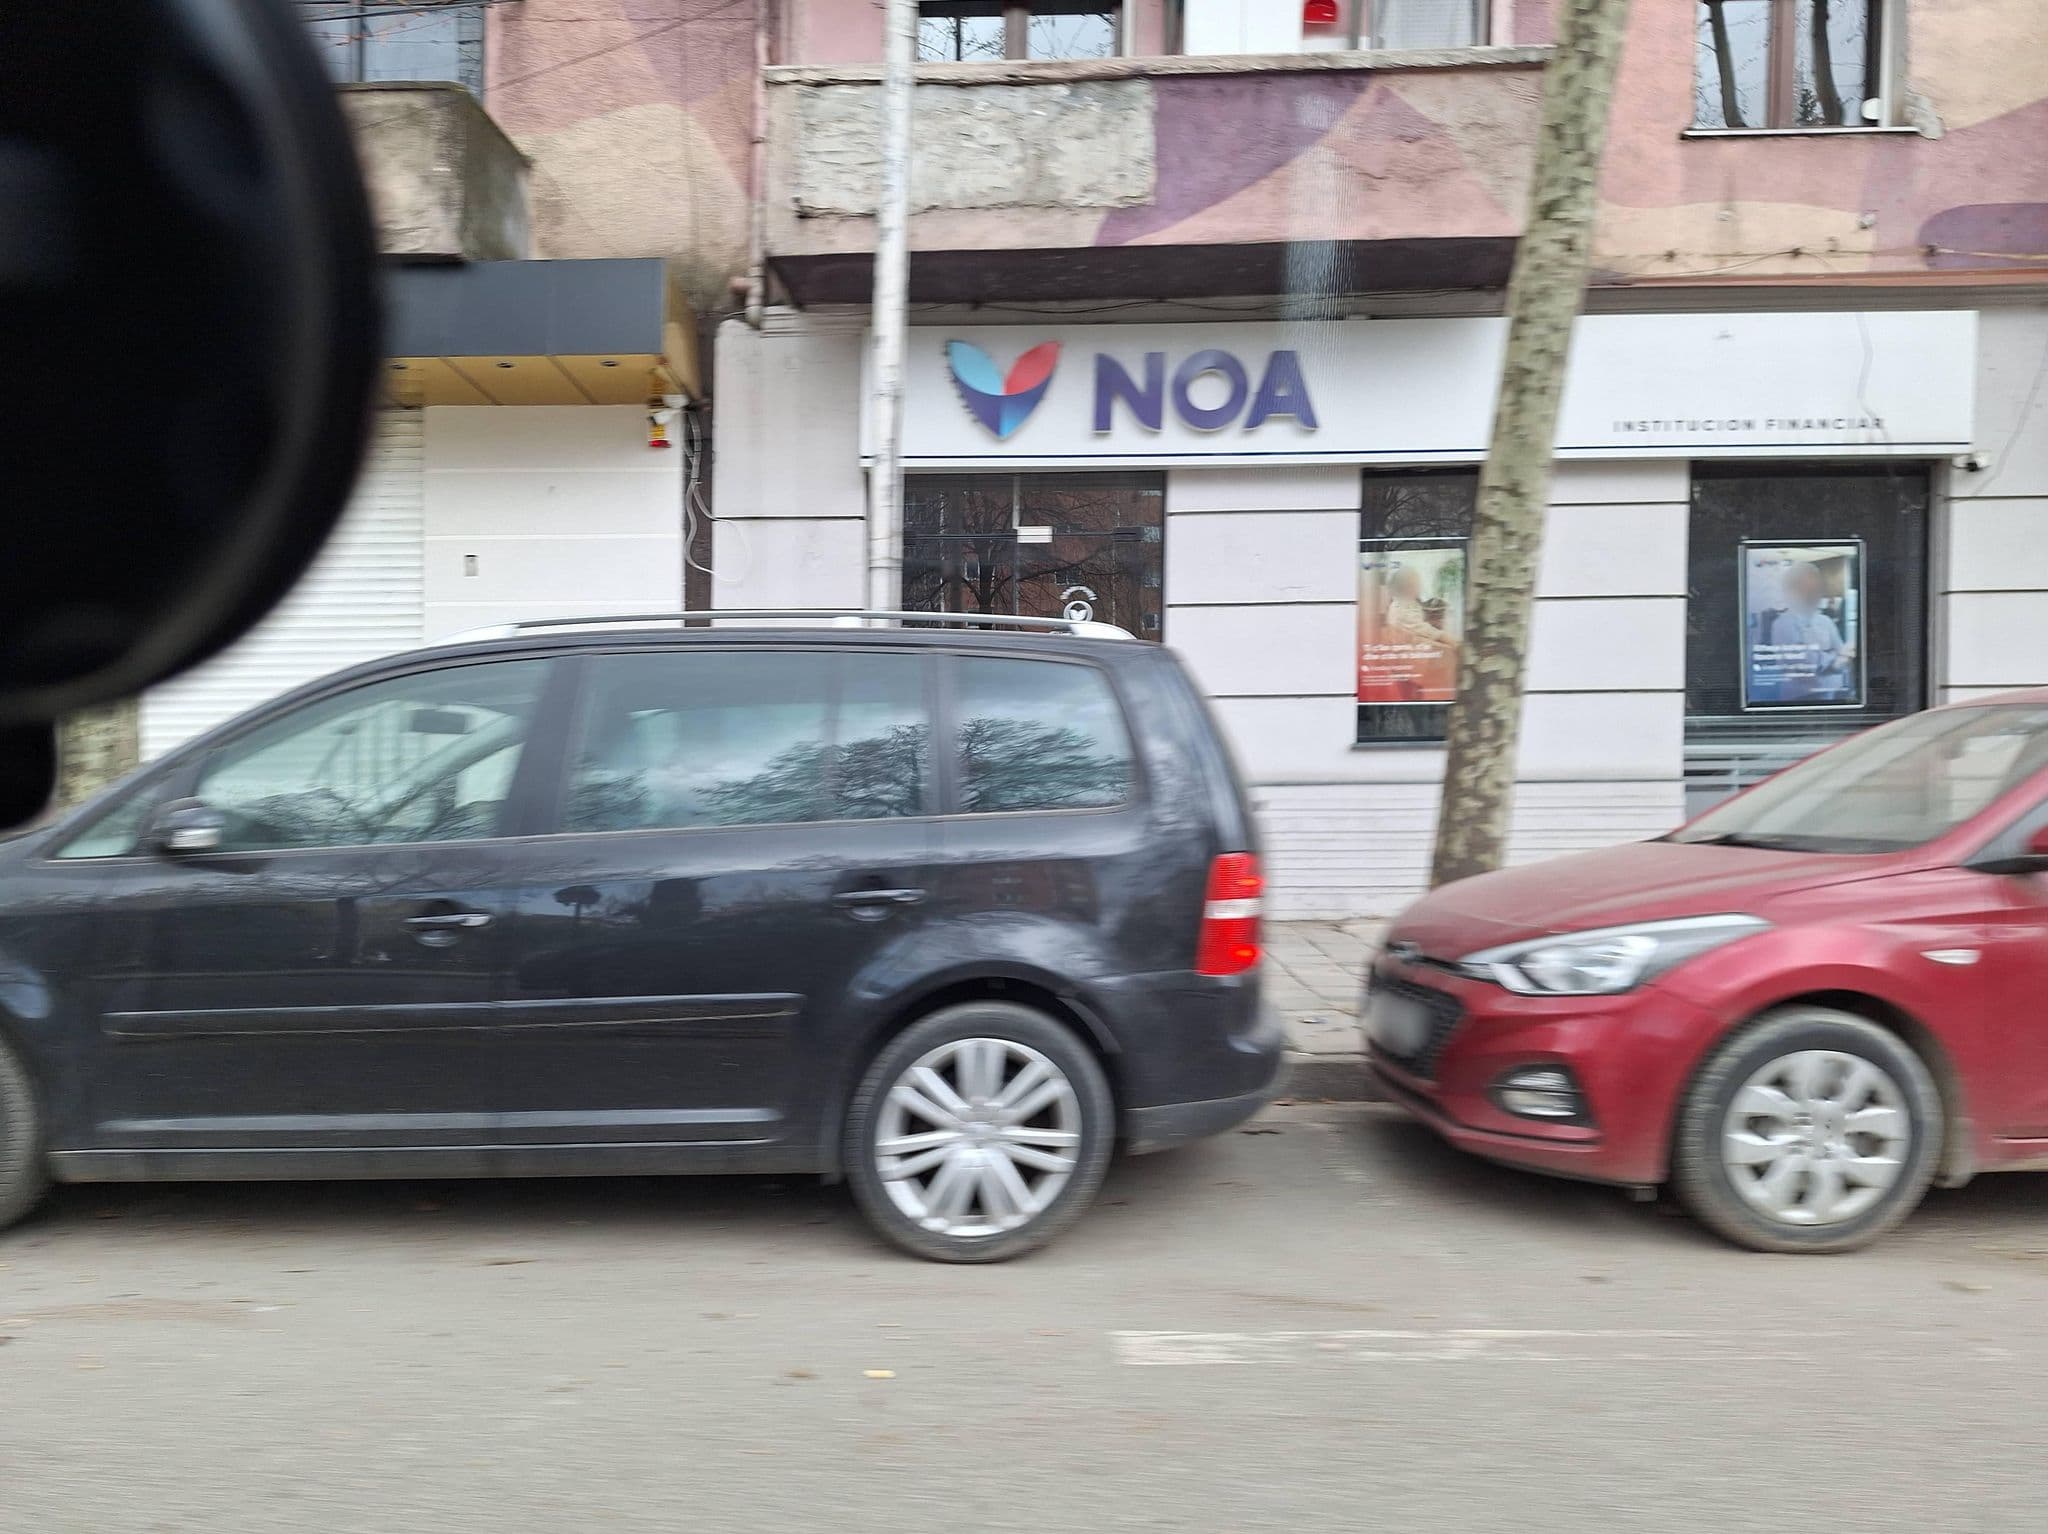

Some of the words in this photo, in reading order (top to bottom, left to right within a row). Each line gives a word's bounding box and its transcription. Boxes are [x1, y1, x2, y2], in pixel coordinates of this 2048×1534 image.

[1092, 348, 1320, 436] NOA
[1613, 419, 1756, 433] INSTITUCION
[1765, 417, 1885, 431] FINANCIAR
